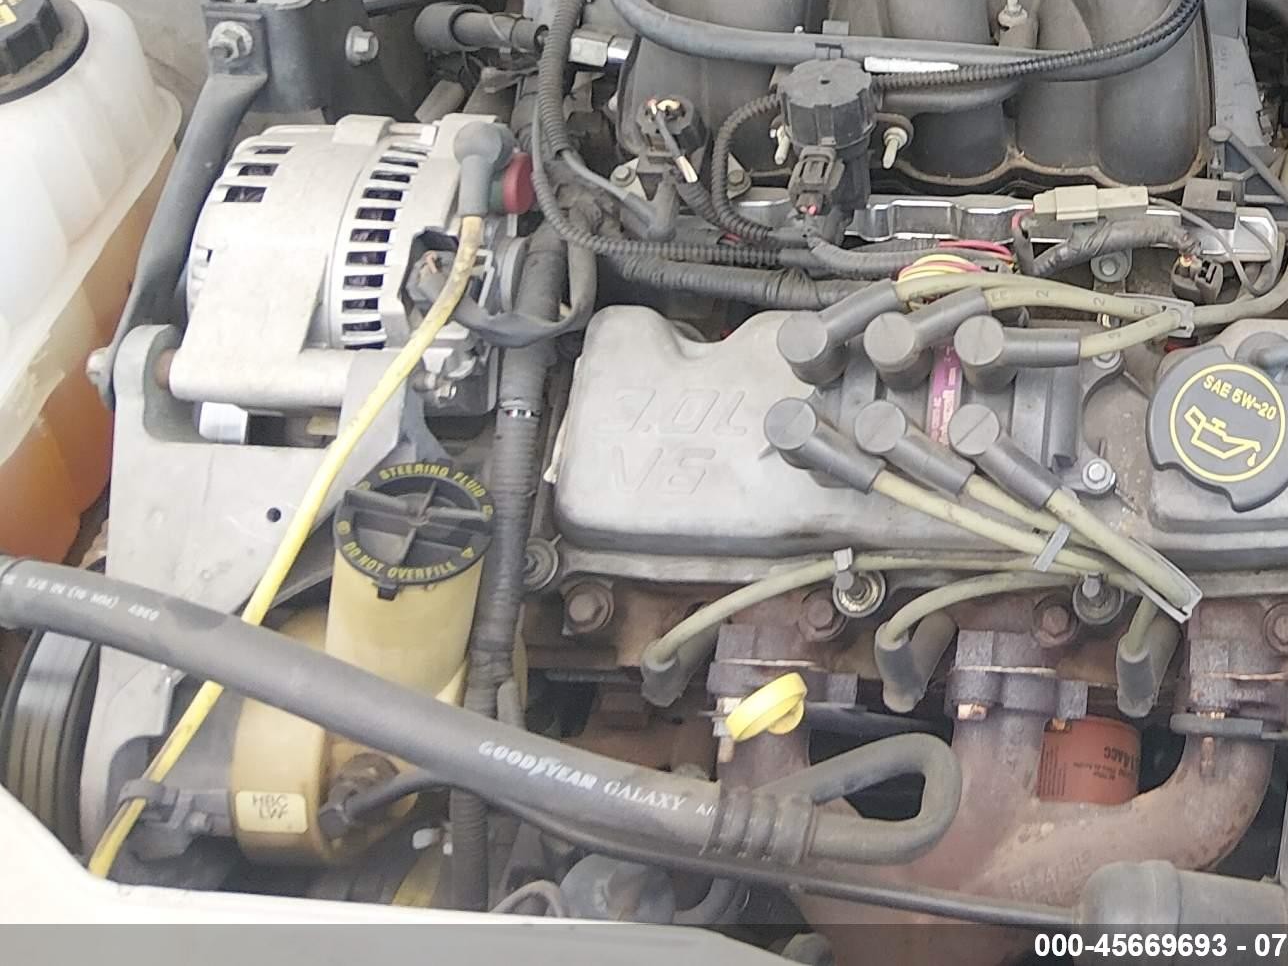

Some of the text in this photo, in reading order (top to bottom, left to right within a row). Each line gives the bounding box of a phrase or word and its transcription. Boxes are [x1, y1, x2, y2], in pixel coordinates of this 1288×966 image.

[1203, 374, 1232, 398] SAE
[378, 463, 487, 498] STEERING FLUID
[342, 541, 457, 579] DO NOT OVERFILL
[478, 740, 599, 791] GOODYEAR
[603, 779, 687, 812] GALAXY
